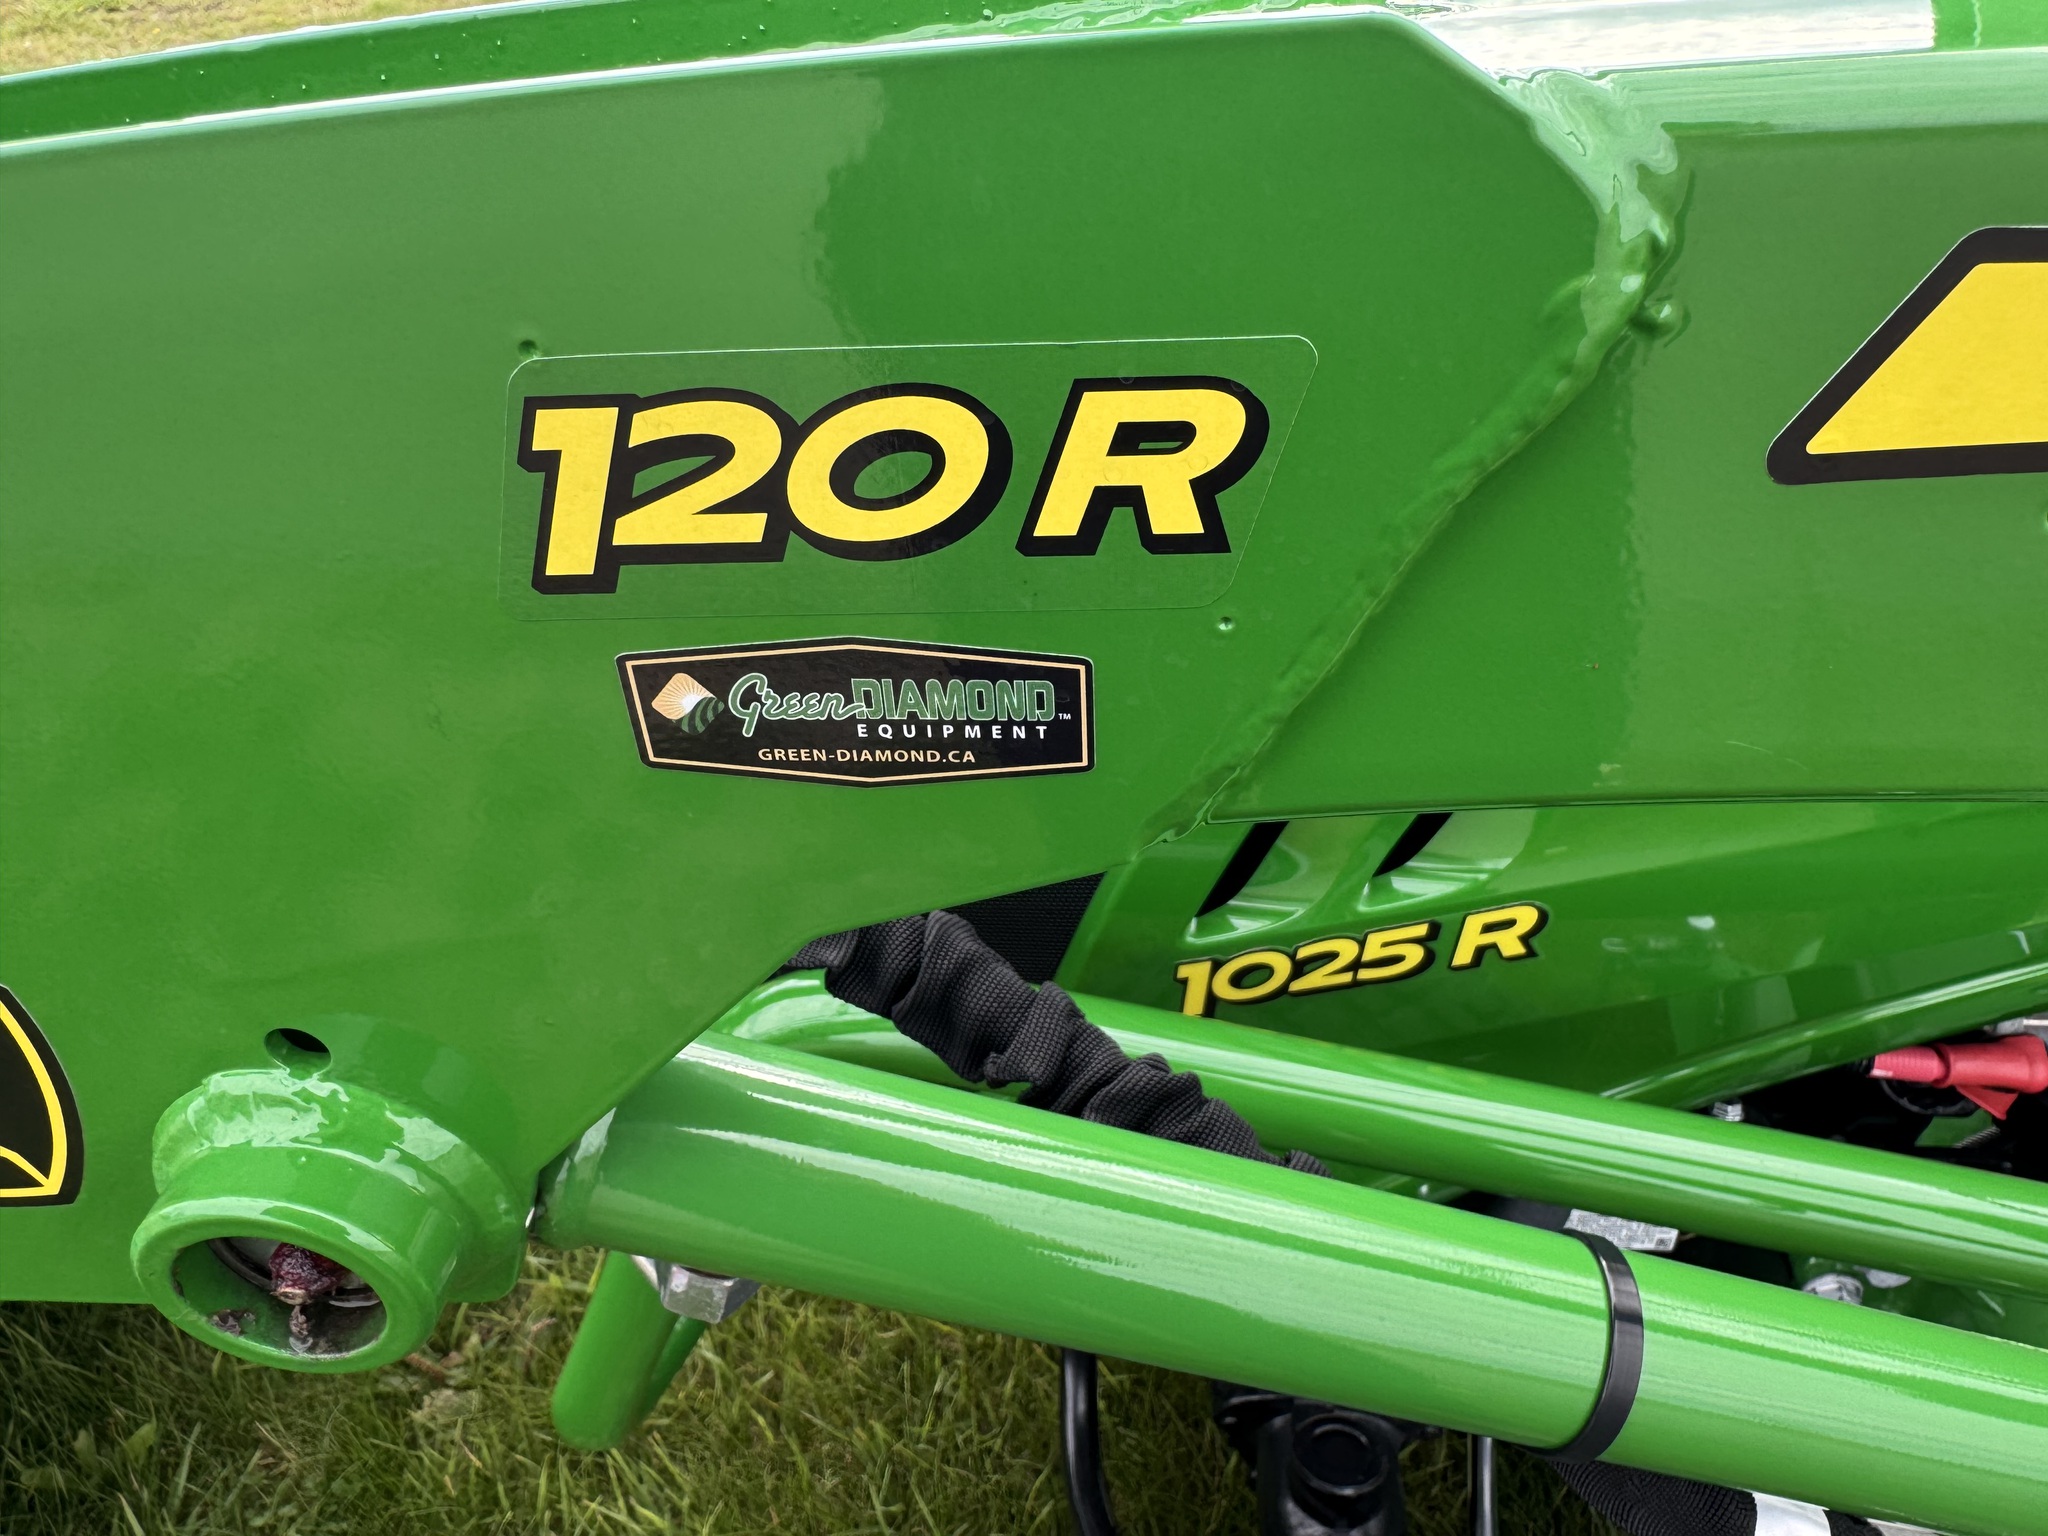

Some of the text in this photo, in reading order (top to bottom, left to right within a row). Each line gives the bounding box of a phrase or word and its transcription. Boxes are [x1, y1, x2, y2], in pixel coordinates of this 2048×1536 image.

[518, 377, 1269, 593] 120 R
[729, 672, 865, 737] Green
[851, 678, 1055, 722] DIAMOND
[857, 723, 1048, 740] EQUIPMENT
[757, 747, 976, 763] GREEN-DIAMOND.CA
[1174, 901, 1549, 1017] 1025 R
